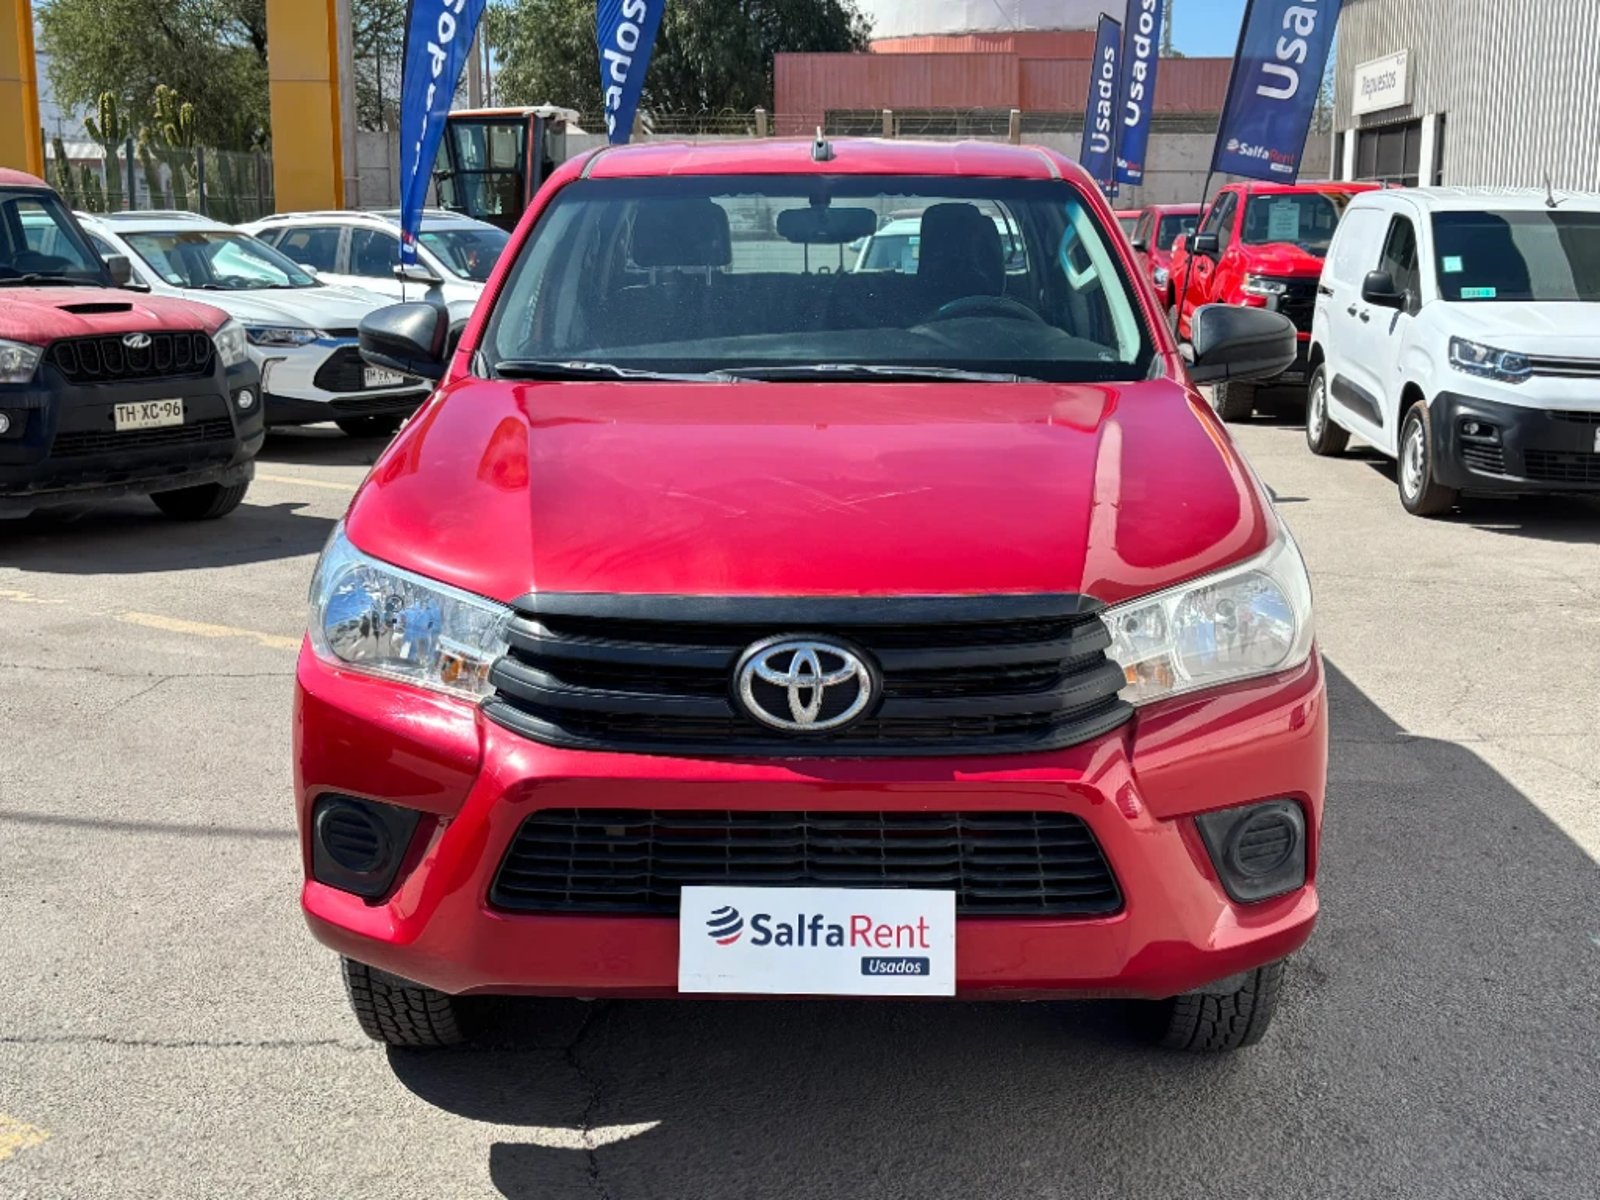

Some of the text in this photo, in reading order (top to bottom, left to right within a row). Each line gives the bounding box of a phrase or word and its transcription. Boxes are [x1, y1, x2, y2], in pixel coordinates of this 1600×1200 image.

[1090, 45, 1115, 153] Usados
[1123, 0, 1157, 127] Usados
[1255, 0, 1318, 100] Usa
[750, 913, 930, 949] SalfaRent
[868, 959, 922, 974] Usados
